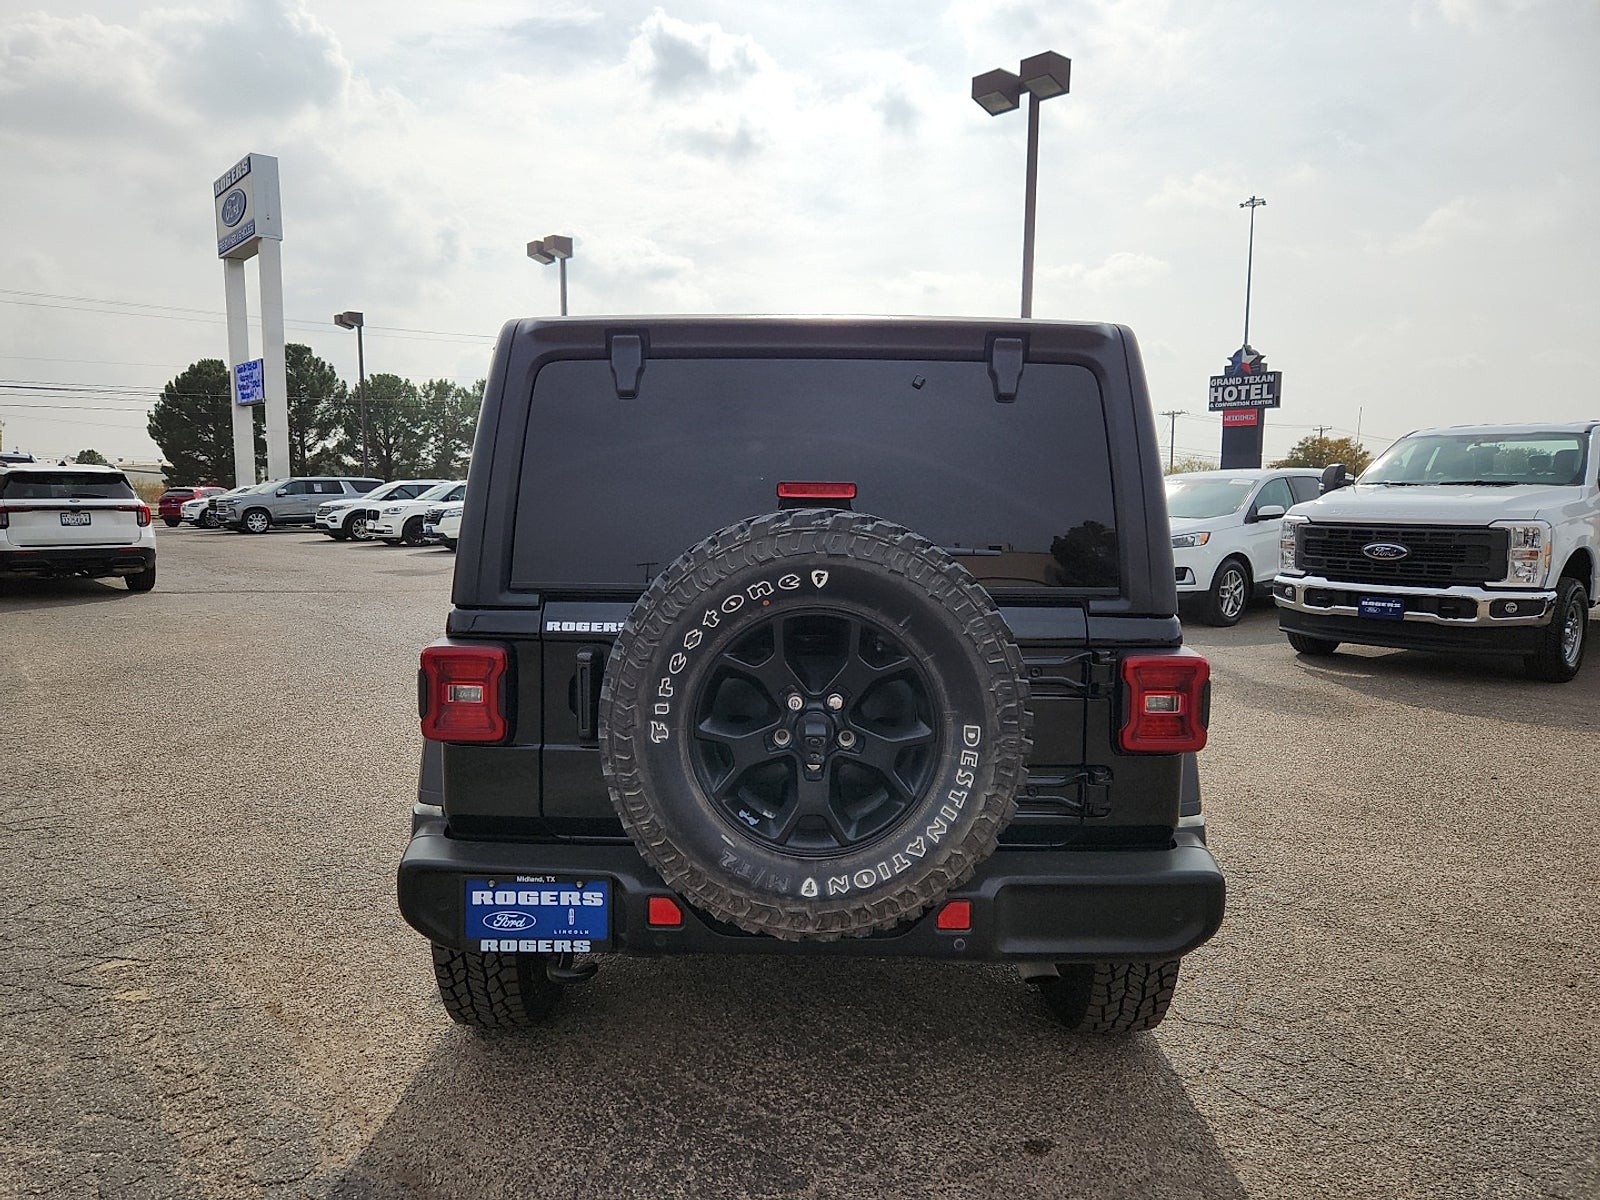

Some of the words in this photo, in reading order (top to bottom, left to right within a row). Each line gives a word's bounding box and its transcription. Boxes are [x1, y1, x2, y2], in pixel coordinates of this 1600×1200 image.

[215, 160, 249, 195] ROGERS
[1210, 377, 1242, 387] GRAND
[1243, 374, 1275, 384] TEXAN
[1210, 384, 1274, 402] HOTEL
[650, 573, 801, 744] Firestone
[827, 724, 982, 897] DESTINATION
[516, 875, 545, 884] Midland,
[471, 890, 604, 907] ROGERS
[492, 913, 527, 928] Ford
[480, 939, 591, 953] ROGERS
